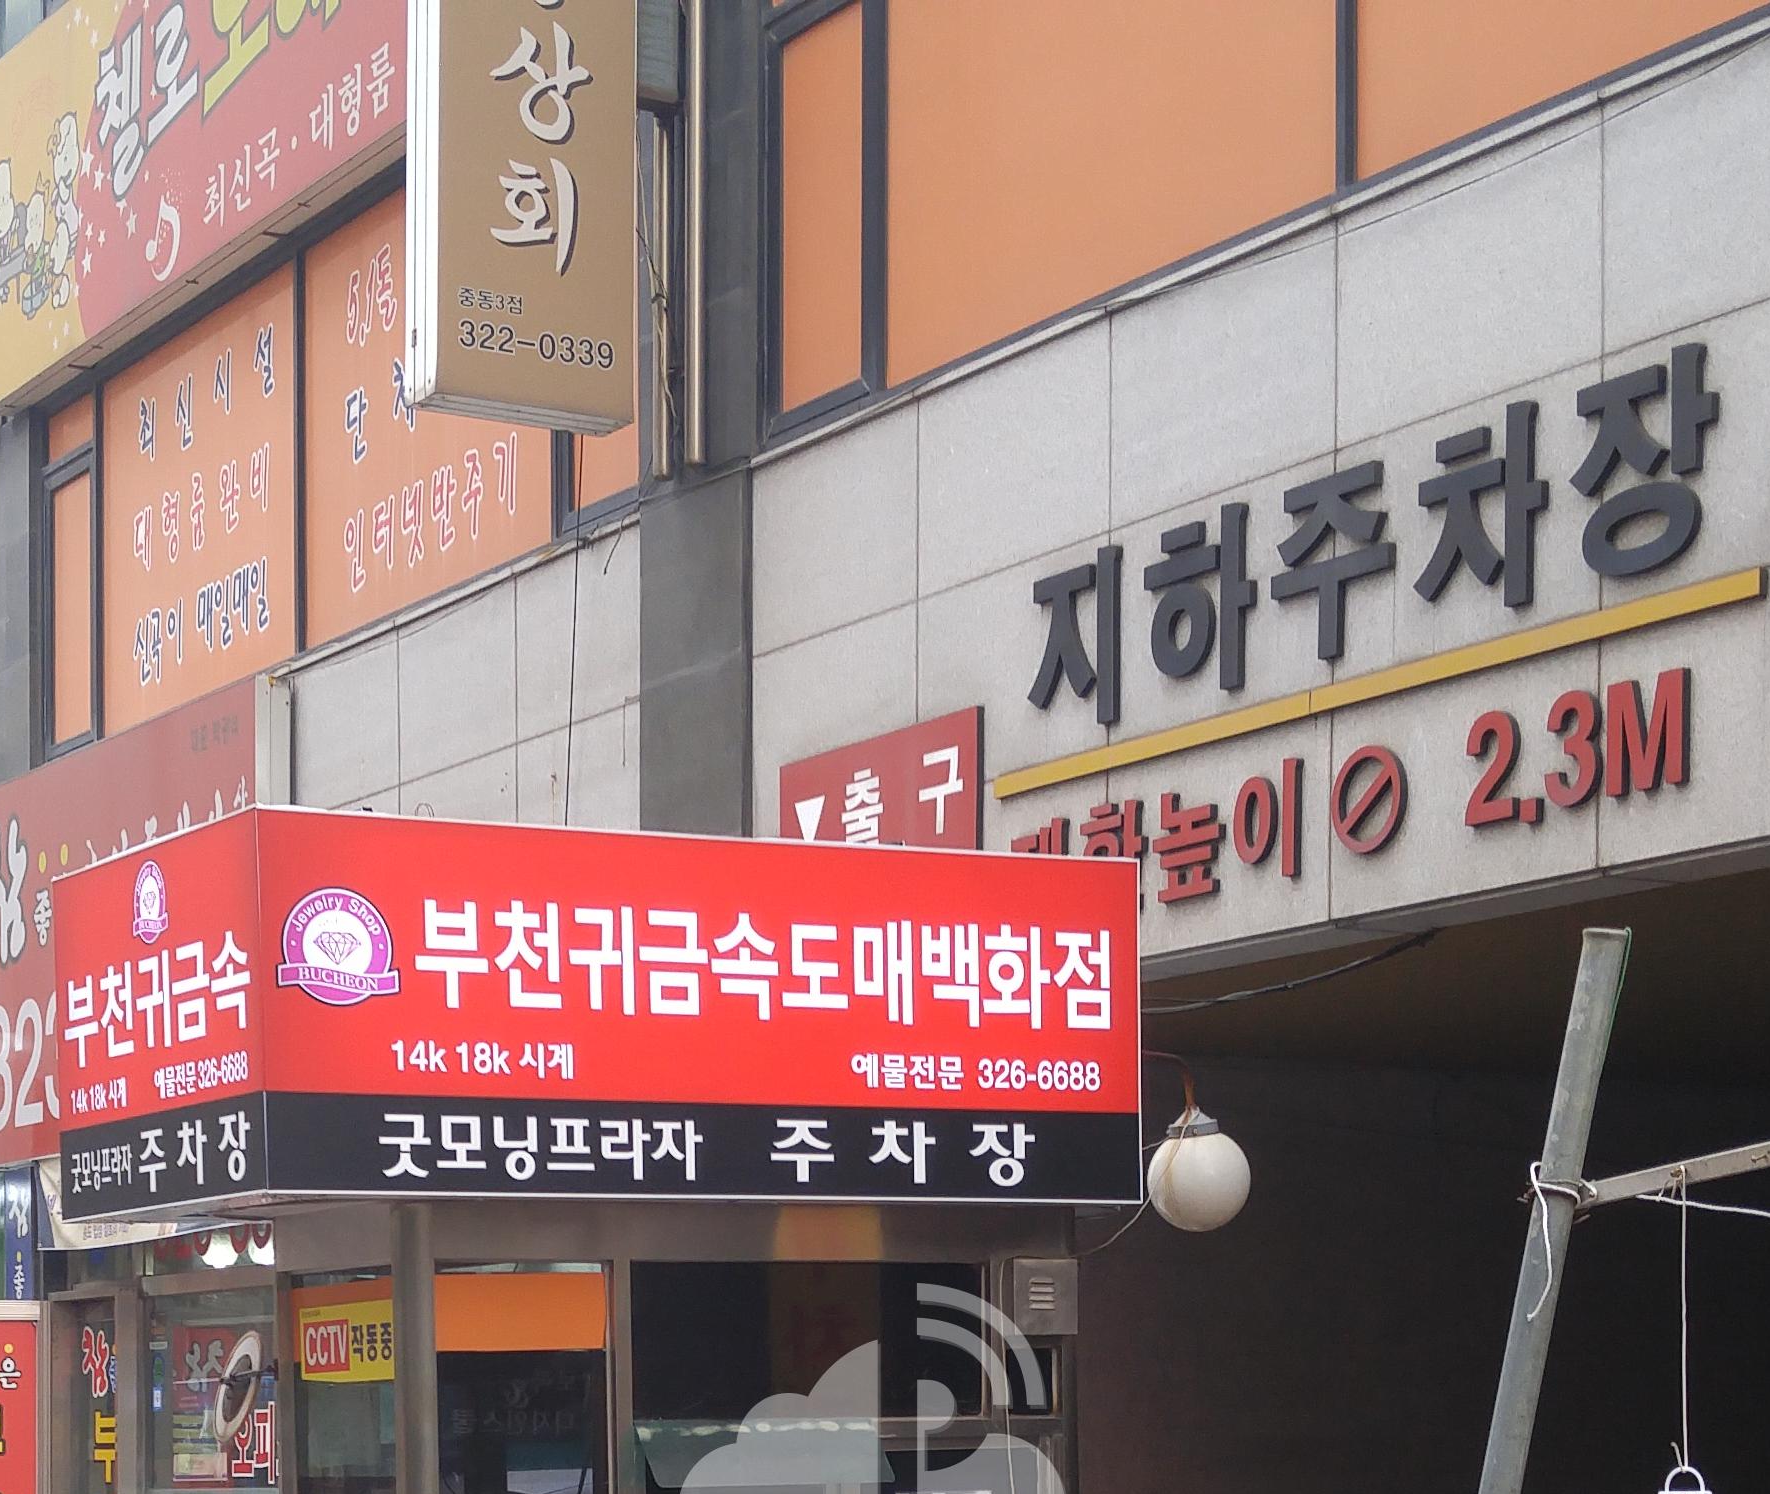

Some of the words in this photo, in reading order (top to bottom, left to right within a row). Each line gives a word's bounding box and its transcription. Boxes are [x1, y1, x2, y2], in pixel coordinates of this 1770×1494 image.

[202, 127, 276, 227] 최신곡
[308, 43, 395, 149] 대형룸
[458, 286, 523, 316] 중동3점
[458, 320, 616, 369] 322-0339
[343, 433, 519, 593] 인터넷반주기
[1028, 342, 1721, 727] 지하주차장
[133, 598, 184, 687] 신곡이
[196, 558, 270, 652] 매일매일
[1465, 667, 1692, 830] 2.3M
[291, 895, 344, 934] Jewelry
[346, 898, 383, 938] Shop
[63, 931, 251, 1068] 부천귀금속
[297, 966, 379, 993] BUCHEON
[415, 896, 1114, 1030] 부천귀금속도매백화점
[71, 1086, 89, 1115] 14k
[89, 1082, 107, 1112] 18k
[108, 1076, 127, 1108] 시계
[154, 1064, 196, 1099] 예물전문
[198, 1050, 248, 1091] 326-6688
[391, 1038, 447, 1073] 14k
[455, 1040, 512, 1077] 18k
[520, 1040, 575, 1079] 시계
[849, 1054, 965, 1091] 예물전문
[978, 1058, 1101, 1092] 326-6688
[71, 1143, 133, 1194] 굿모닝프라자
[138, 1110, 251, 1193] 주차장
[379, 1112, 703, 1180] 굿모닝프라자
[770, 1117, 1036, 1187] 주차장
[305, 1323, 348, 1367] CCTV
[351, 1322, 392, 1363] 작동중
[231, 1401, 279, 1484] 오피
